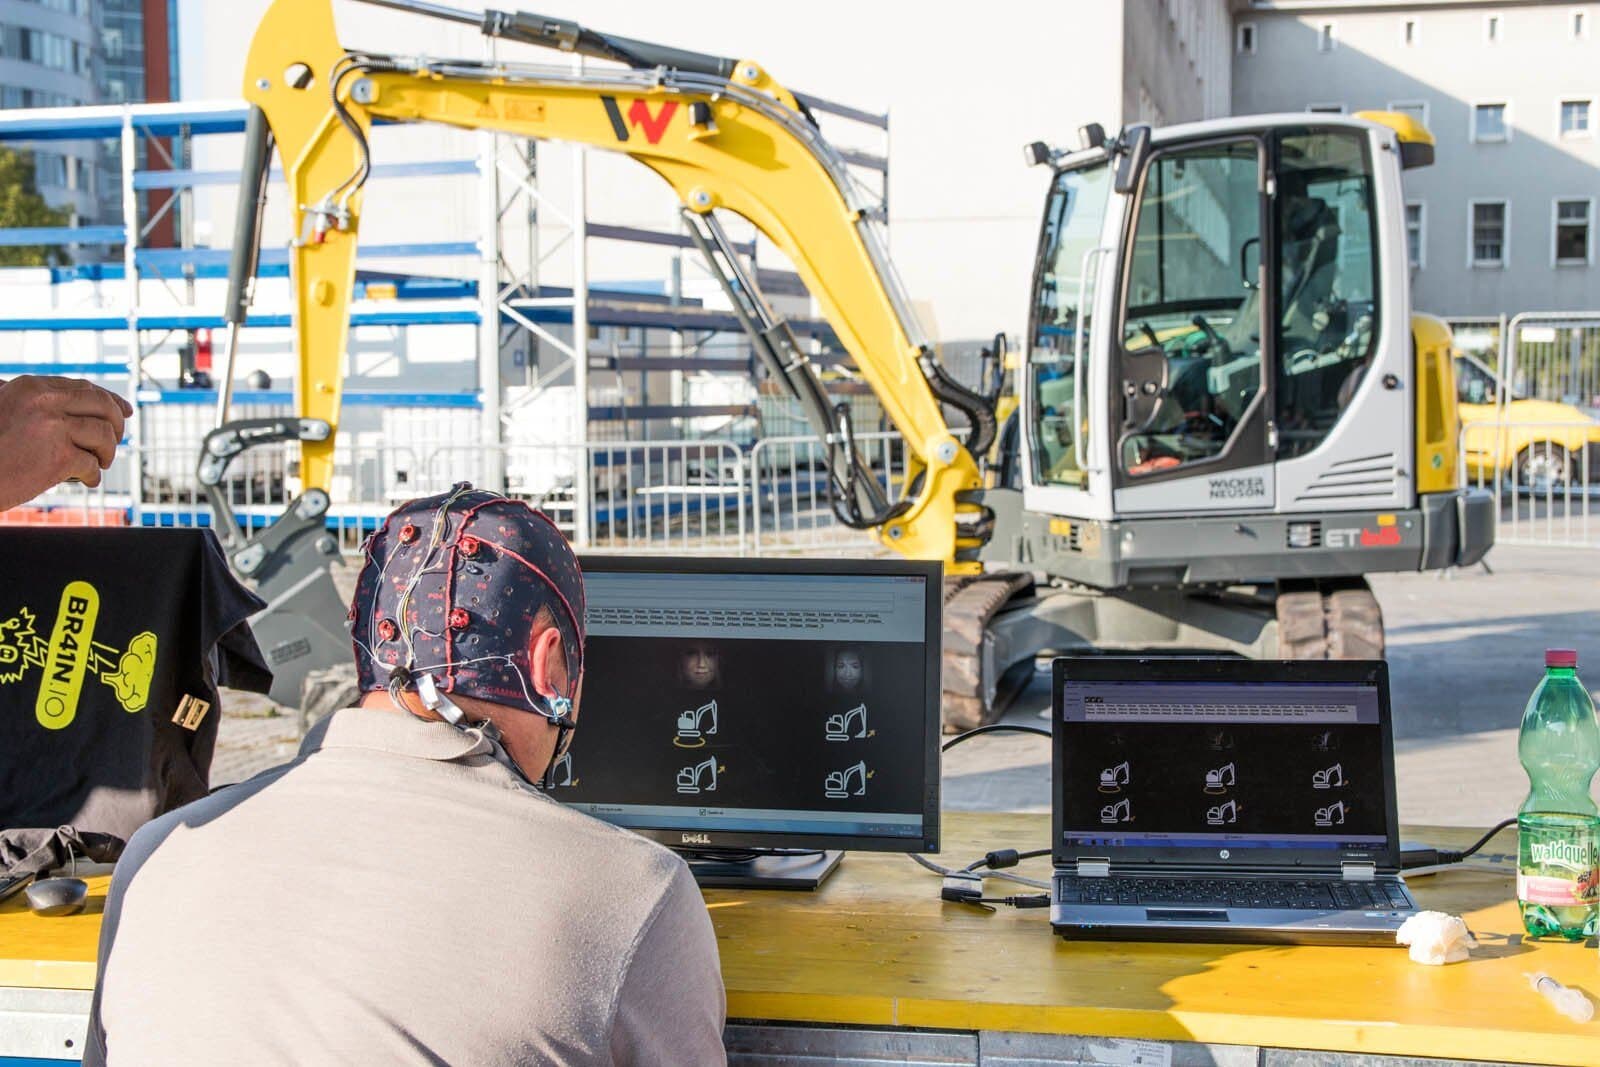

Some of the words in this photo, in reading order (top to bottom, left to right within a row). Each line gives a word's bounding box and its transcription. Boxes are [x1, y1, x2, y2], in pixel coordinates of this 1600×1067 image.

[1208, 477, 1264, 489] WACKER
[1209, 488, 1265, 499] NEUSON
[681, 833, 711, 844] DELL
[1532, 841, 1598, 865] waldquelle
